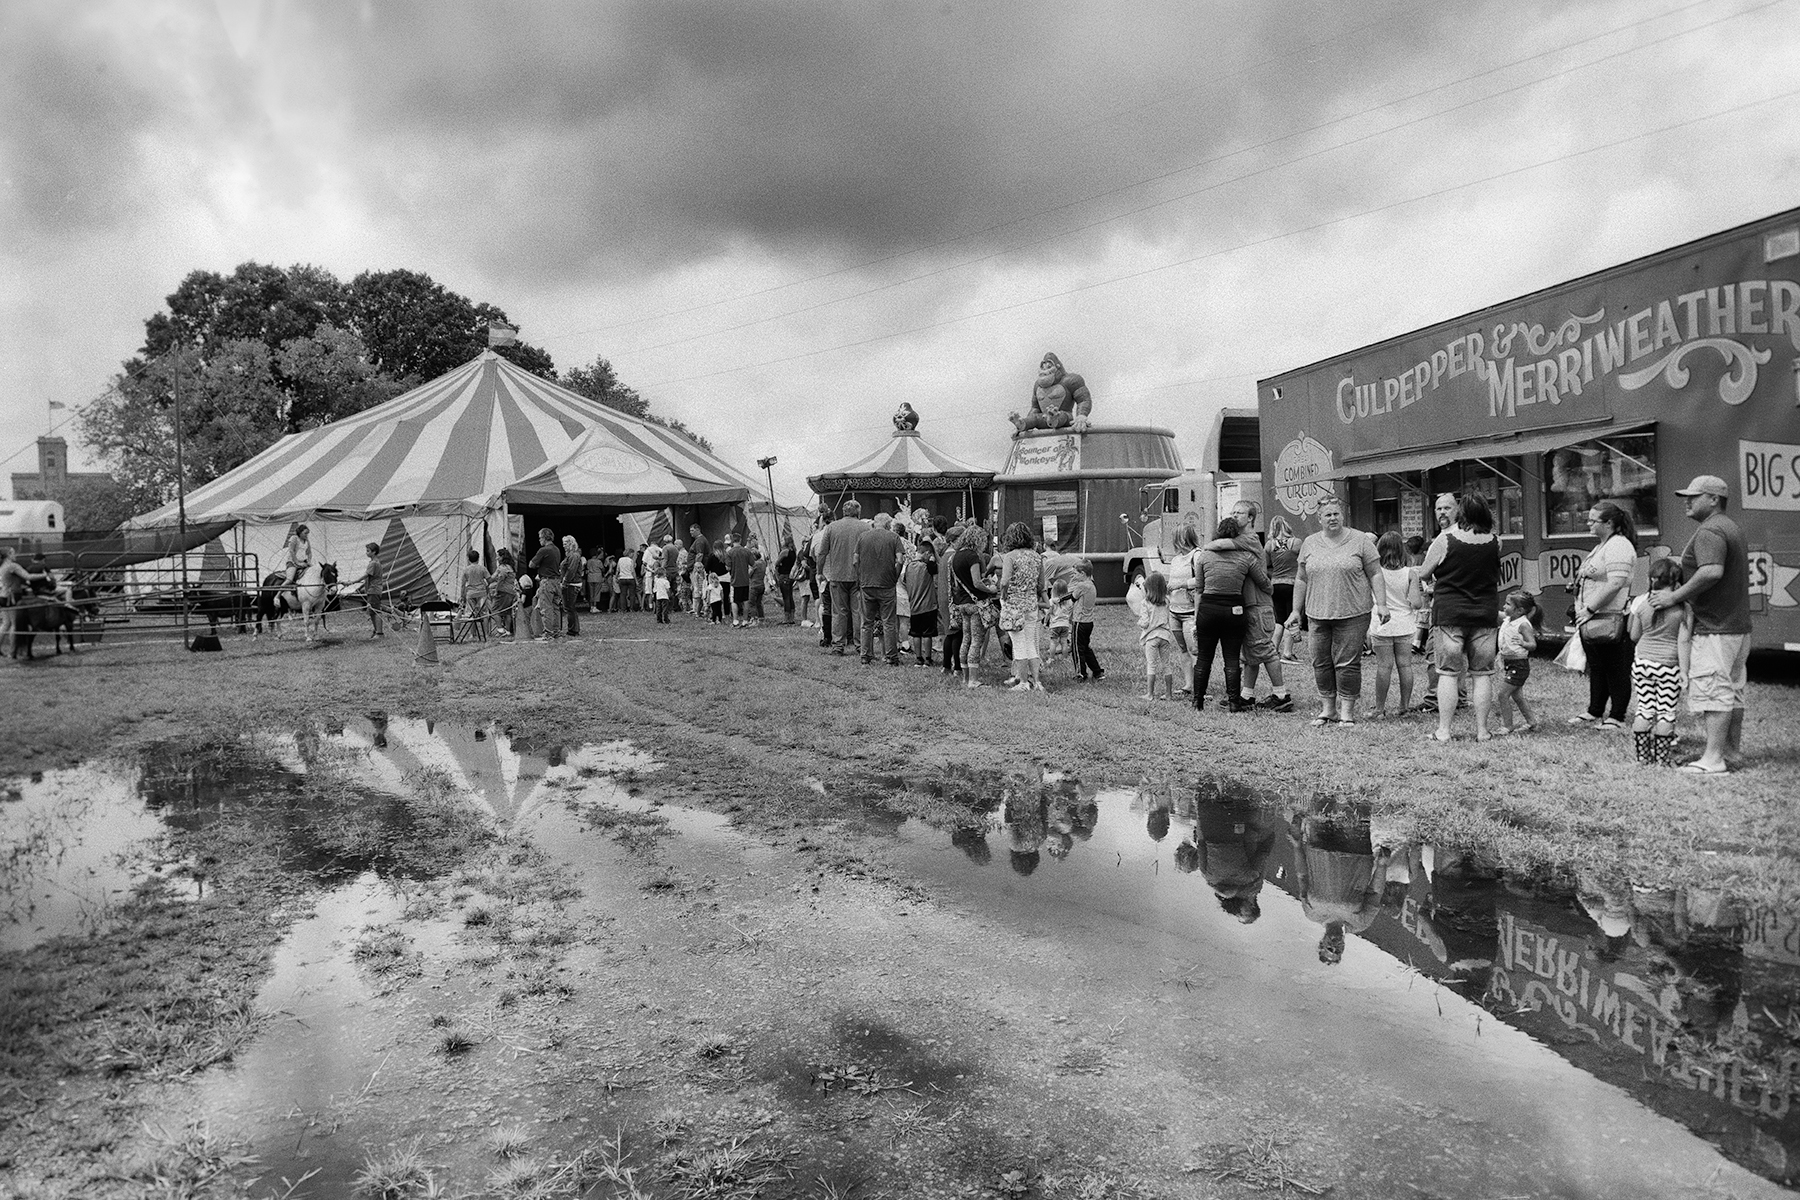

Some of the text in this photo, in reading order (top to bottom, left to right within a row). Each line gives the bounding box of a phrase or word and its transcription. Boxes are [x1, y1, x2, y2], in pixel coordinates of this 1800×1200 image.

[1336, 332, 1490, 424] CULPEPPER
[1487, 280, 1800, 417] MERRIWEATHER
[1283, 463, 1320, 482] COMBINED
[1745, 452, 1785, 497] BIG
